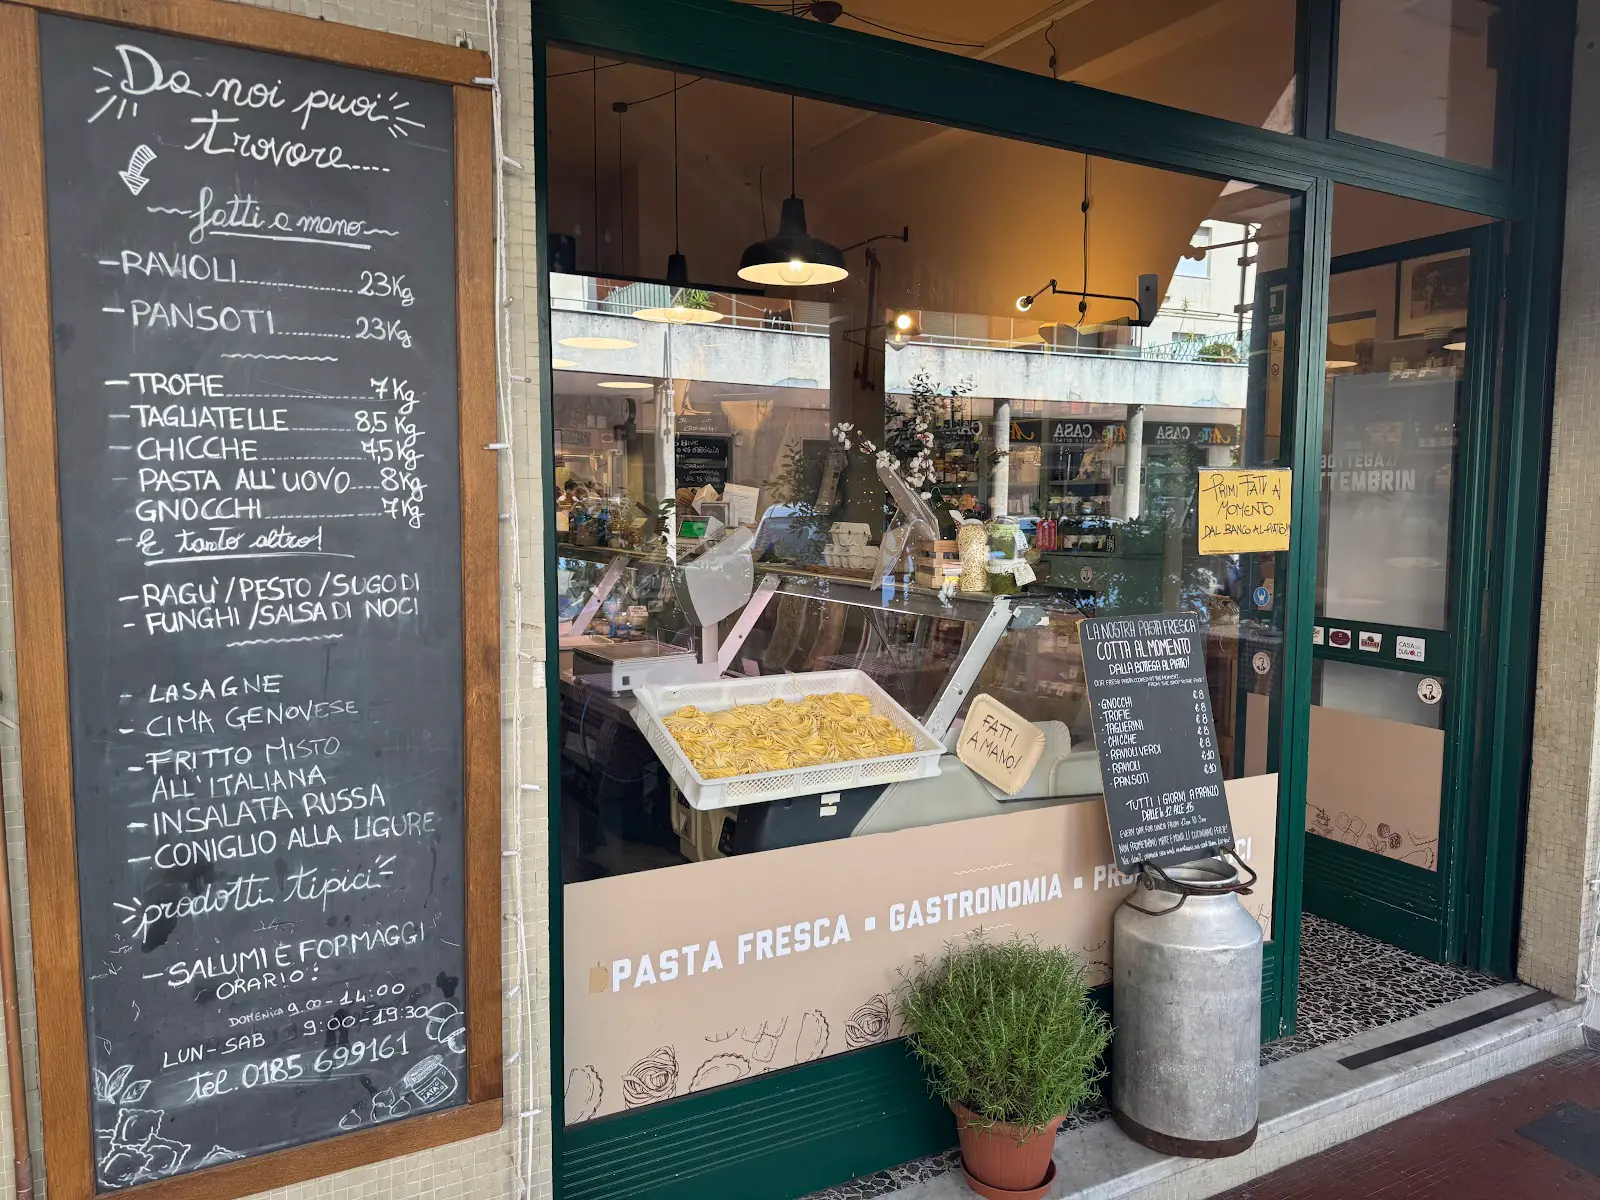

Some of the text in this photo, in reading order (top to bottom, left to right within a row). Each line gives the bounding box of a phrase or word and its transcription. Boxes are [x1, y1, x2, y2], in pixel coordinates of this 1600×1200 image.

[207, 79, 285, 108] noi
[292, 90, 388, 129] puoi
[188, 186, 261, 243] fatti
[297, 214, 365, 236] mano
[121, 250, 237, 283] RAVIOLI
[131, 299, 275, 335] PANSOTI
[130, 373, 225, 398] TROFIE
[130, 405, 289, 432] TAGLIATELLE
[137, 436, 258, 462] CHICCHE
[138, 468, 222, 493] PASTA
[135, 497, 262, 523] GNOCCHI
[1216, 500, 1275, 520] MOMENTO
[144, 606, 240, 636] FUNGHI
[365, 597, 420, 620] NOCI
[1163, 618, 1197, 636] FRESCA
[1096, 640, 1132, 661] COTTA
[1147, 637, 1192, 657] MOMENTO
[149, 674, 284, 704] LASAGNE
[1100, 696, 1133, 710] GNOCCHI
[146, 699, 360, 738] CIMA GENOVESE
[1102, 709, 1132, 723] TROFIE
[966, 730, 979, 751] A
[1107, 733, 1138, 748] CHICCHE
[145, 736, 341, 776] FRITTO MISTO
[1112, 772, 1150, 789] PANSOTI
[153, 783, 386, 836] INSALATA RUSSA
[1125, 795, 1154, 812] TUTTI
[155, 811, 437, 869] CONIGLIO ALLA LIGURE
[132, 865, 382, 944] prodotti tipici
[612, 940, 724, 993] PASTA
[737, 914, 852, 966] FRESCA
[889, 873, 1063, 933] GASTRONOMIA
[166, 946, 269, 988] SALUMI
[241, 1053, 304, 1090] 0185
[313, 1030, 410, 1074] 699161
